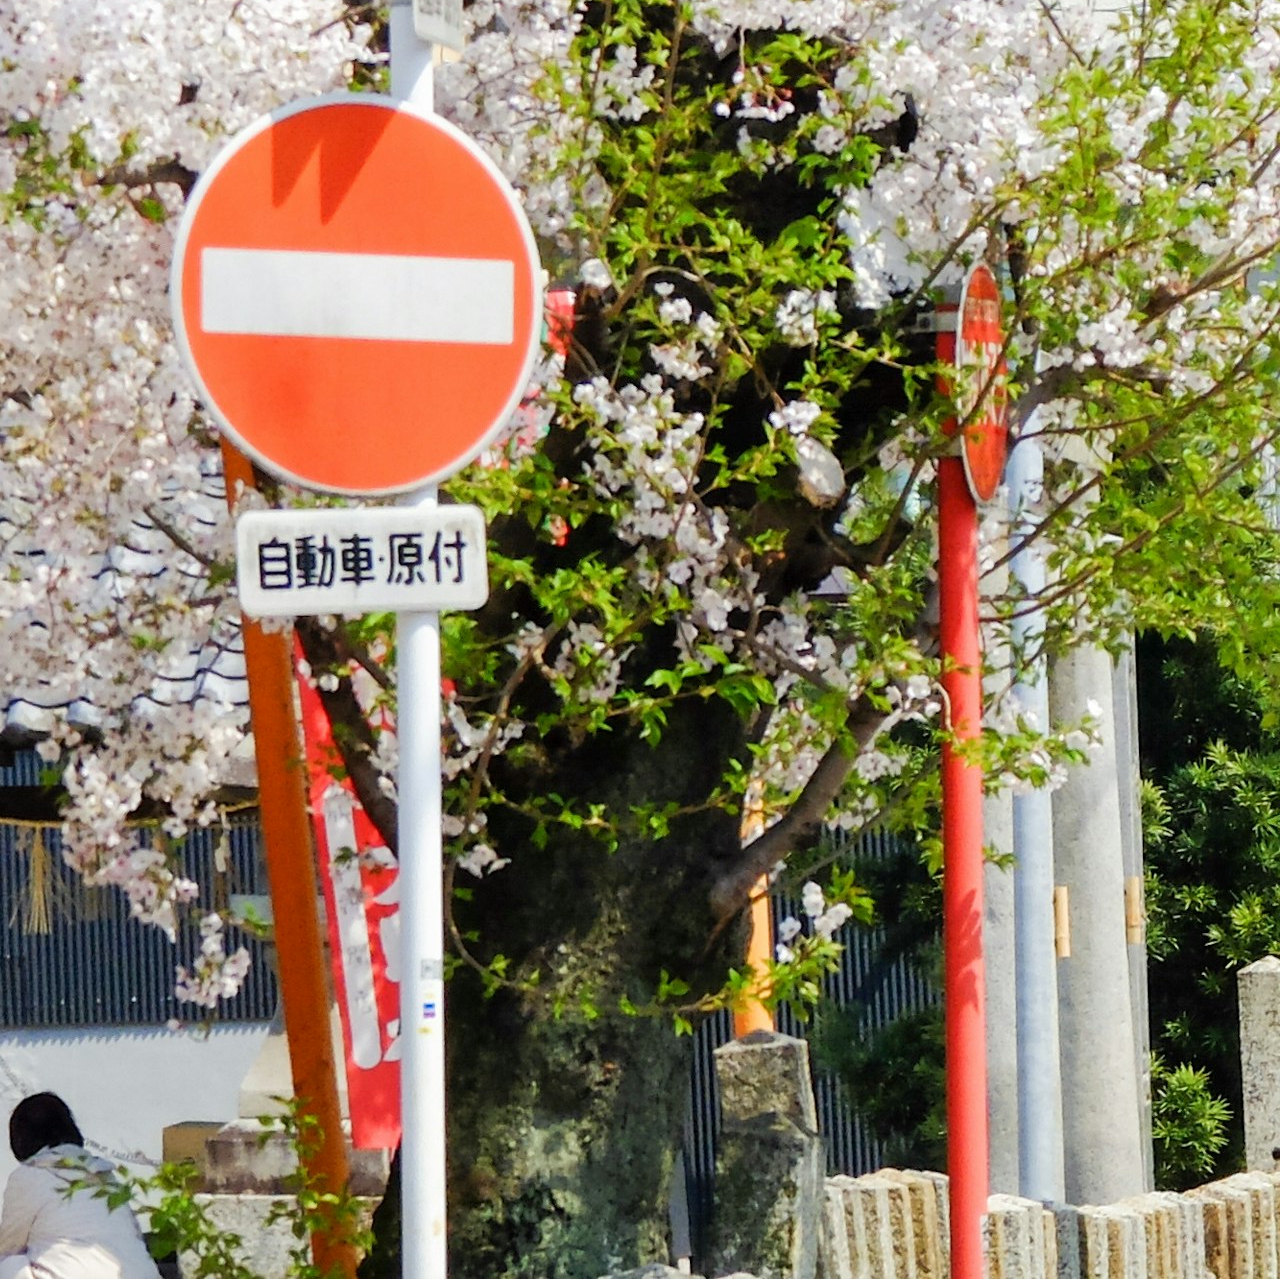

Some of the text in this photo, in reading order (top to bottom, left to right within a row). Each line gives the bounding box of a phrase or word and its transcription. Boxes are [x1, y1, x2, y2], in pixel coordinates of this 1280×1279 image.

[258, 530, 467, 590] 自動車・原付
